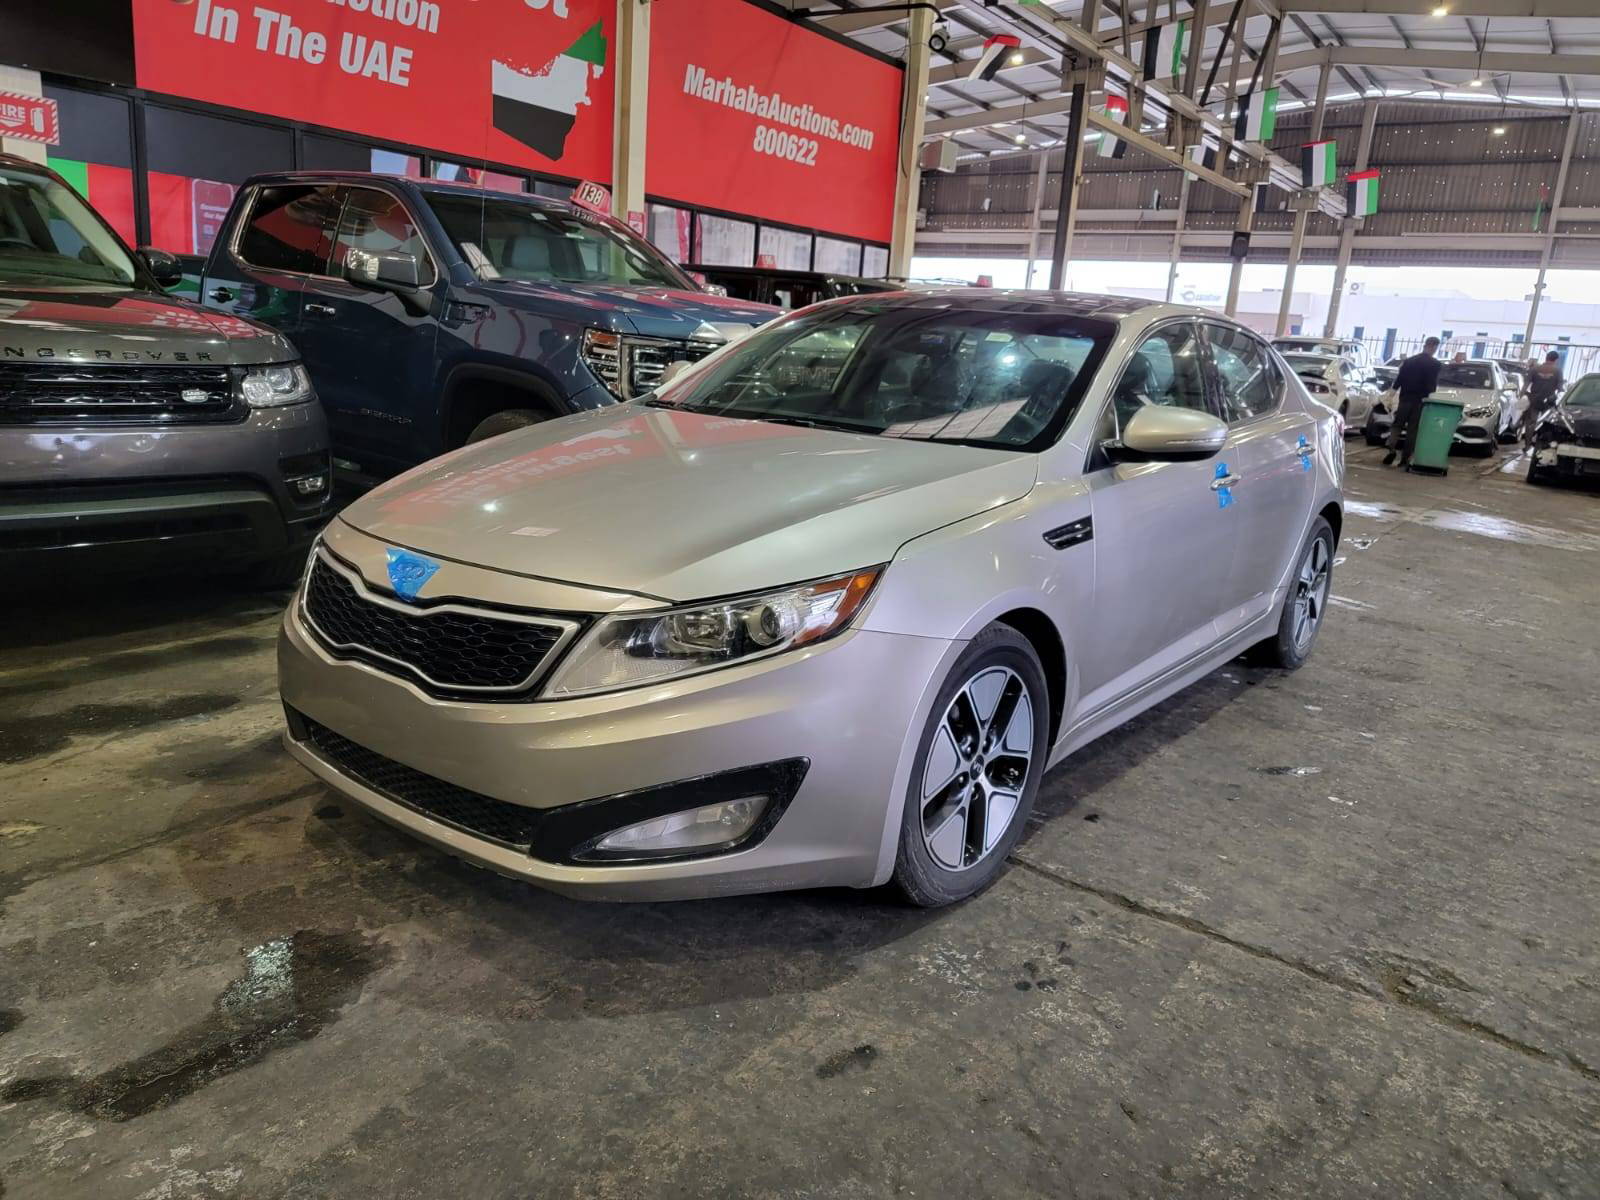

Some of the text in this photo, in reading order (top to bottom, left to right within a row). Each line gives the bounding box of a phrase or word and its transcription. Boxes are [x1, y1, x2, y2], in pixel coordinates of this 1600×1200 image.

[193, 0, 414, 88] In The UAE
[0, 103, 26, 122] IRE
[683, 63, 875, 151] MarhabaAuctions.com
[753, 124, 819, 167] 800622
[580, 183, 603, 206] 138
